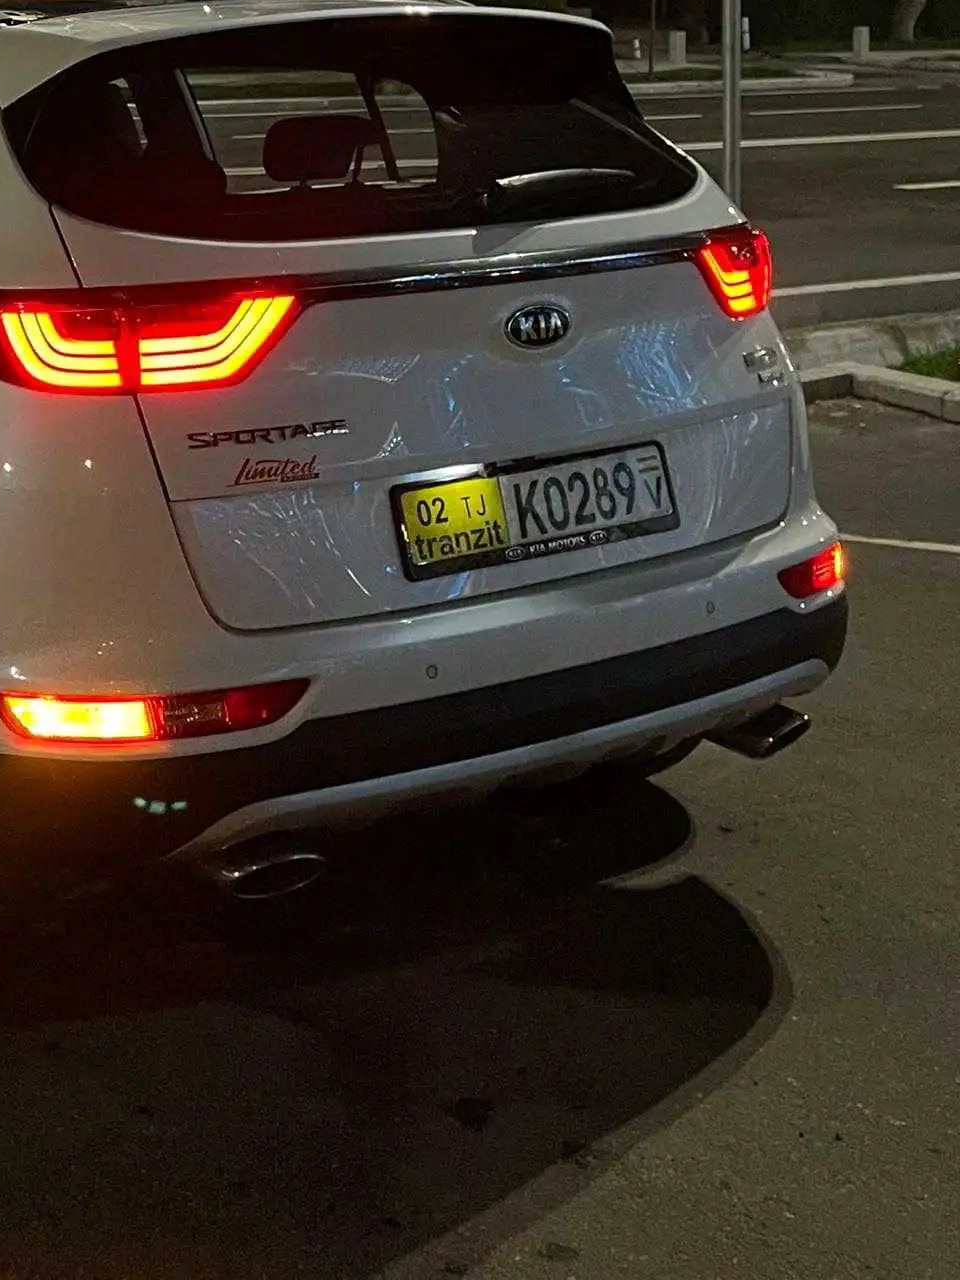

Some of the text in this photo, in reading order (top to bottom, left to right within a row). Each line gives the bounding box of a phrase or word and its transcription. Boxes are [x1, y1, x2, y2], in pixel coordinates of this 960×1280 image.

[519, 311, 568, 341] KIA
[187, 419, 350, 450] SPORTAGE
[229, 454, 318, 486] Limited
[417, 493, 487, 526] 02 TJ
[514, 462, 663, 539] K0289 V
[415, 520, 504, 560] tranzit
